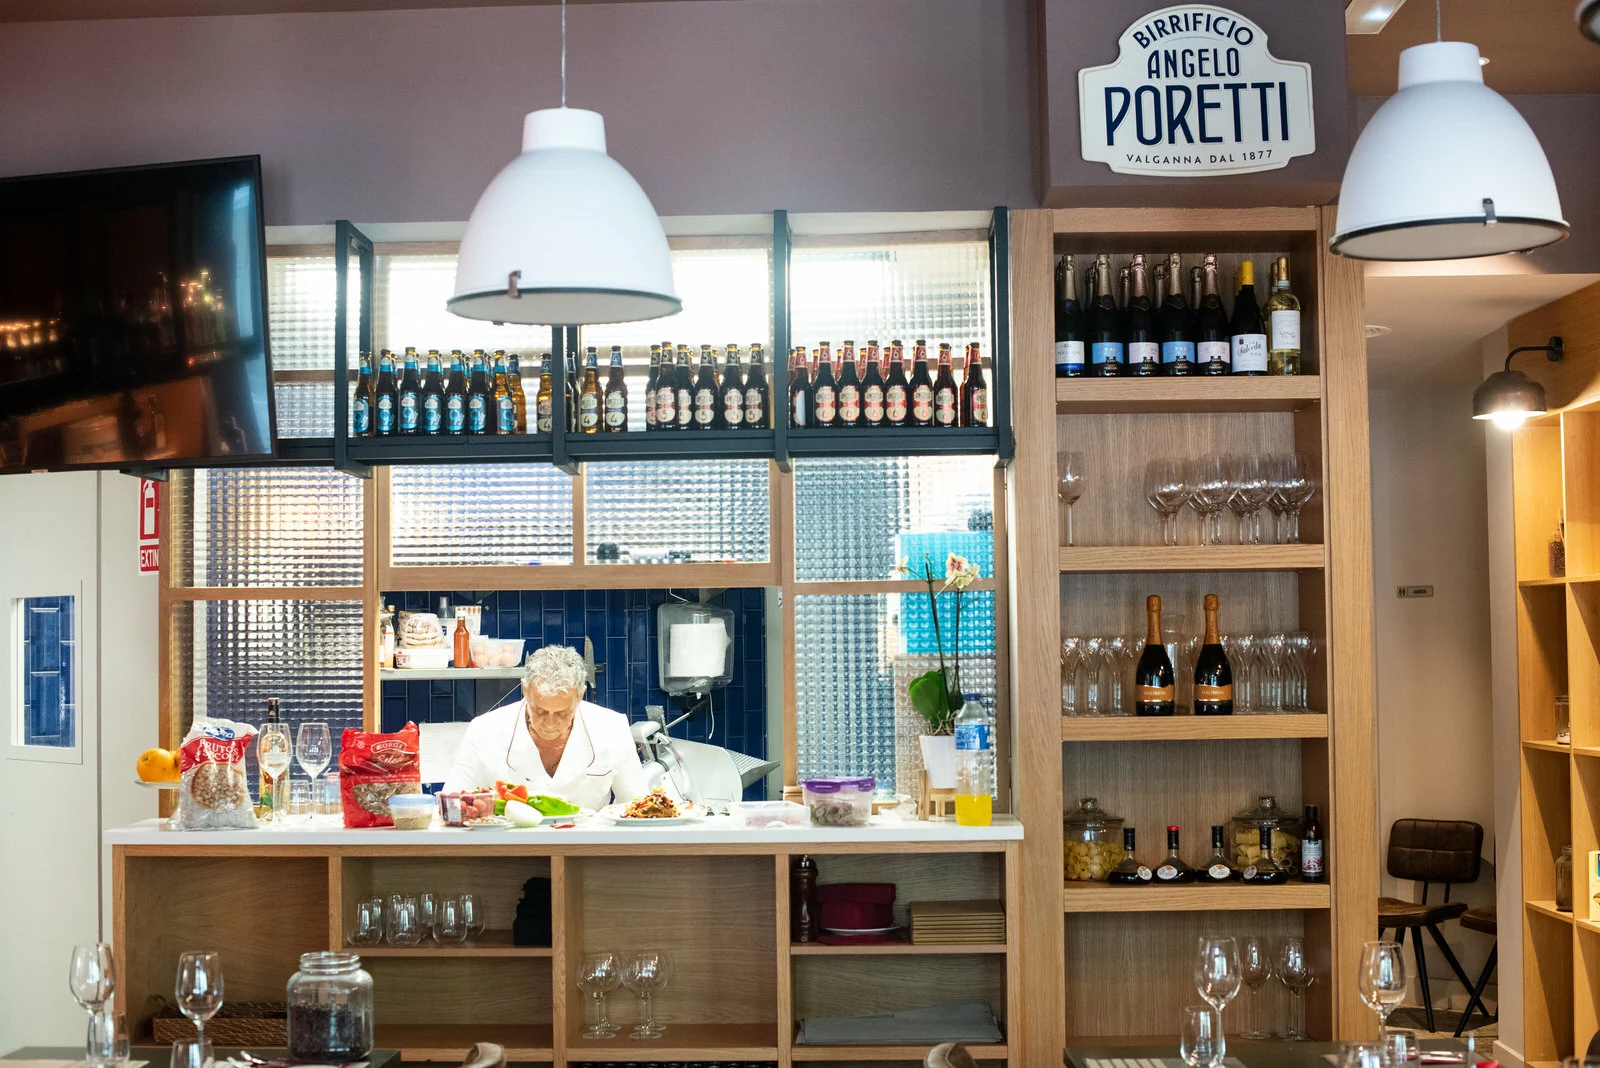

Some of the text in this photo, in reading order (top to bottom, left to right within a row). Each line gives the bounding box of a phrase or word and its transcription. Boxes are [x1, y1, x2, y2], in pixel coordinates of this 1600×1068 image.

[1132, 12, 1254, 49] BIRRIFICIO
[1148, 48, 1240, 78] ANGELO
[1104, 82, 1289, 146] PORETTI
[1126, 150, 1272, 164] VALGANNA DAL 1877
